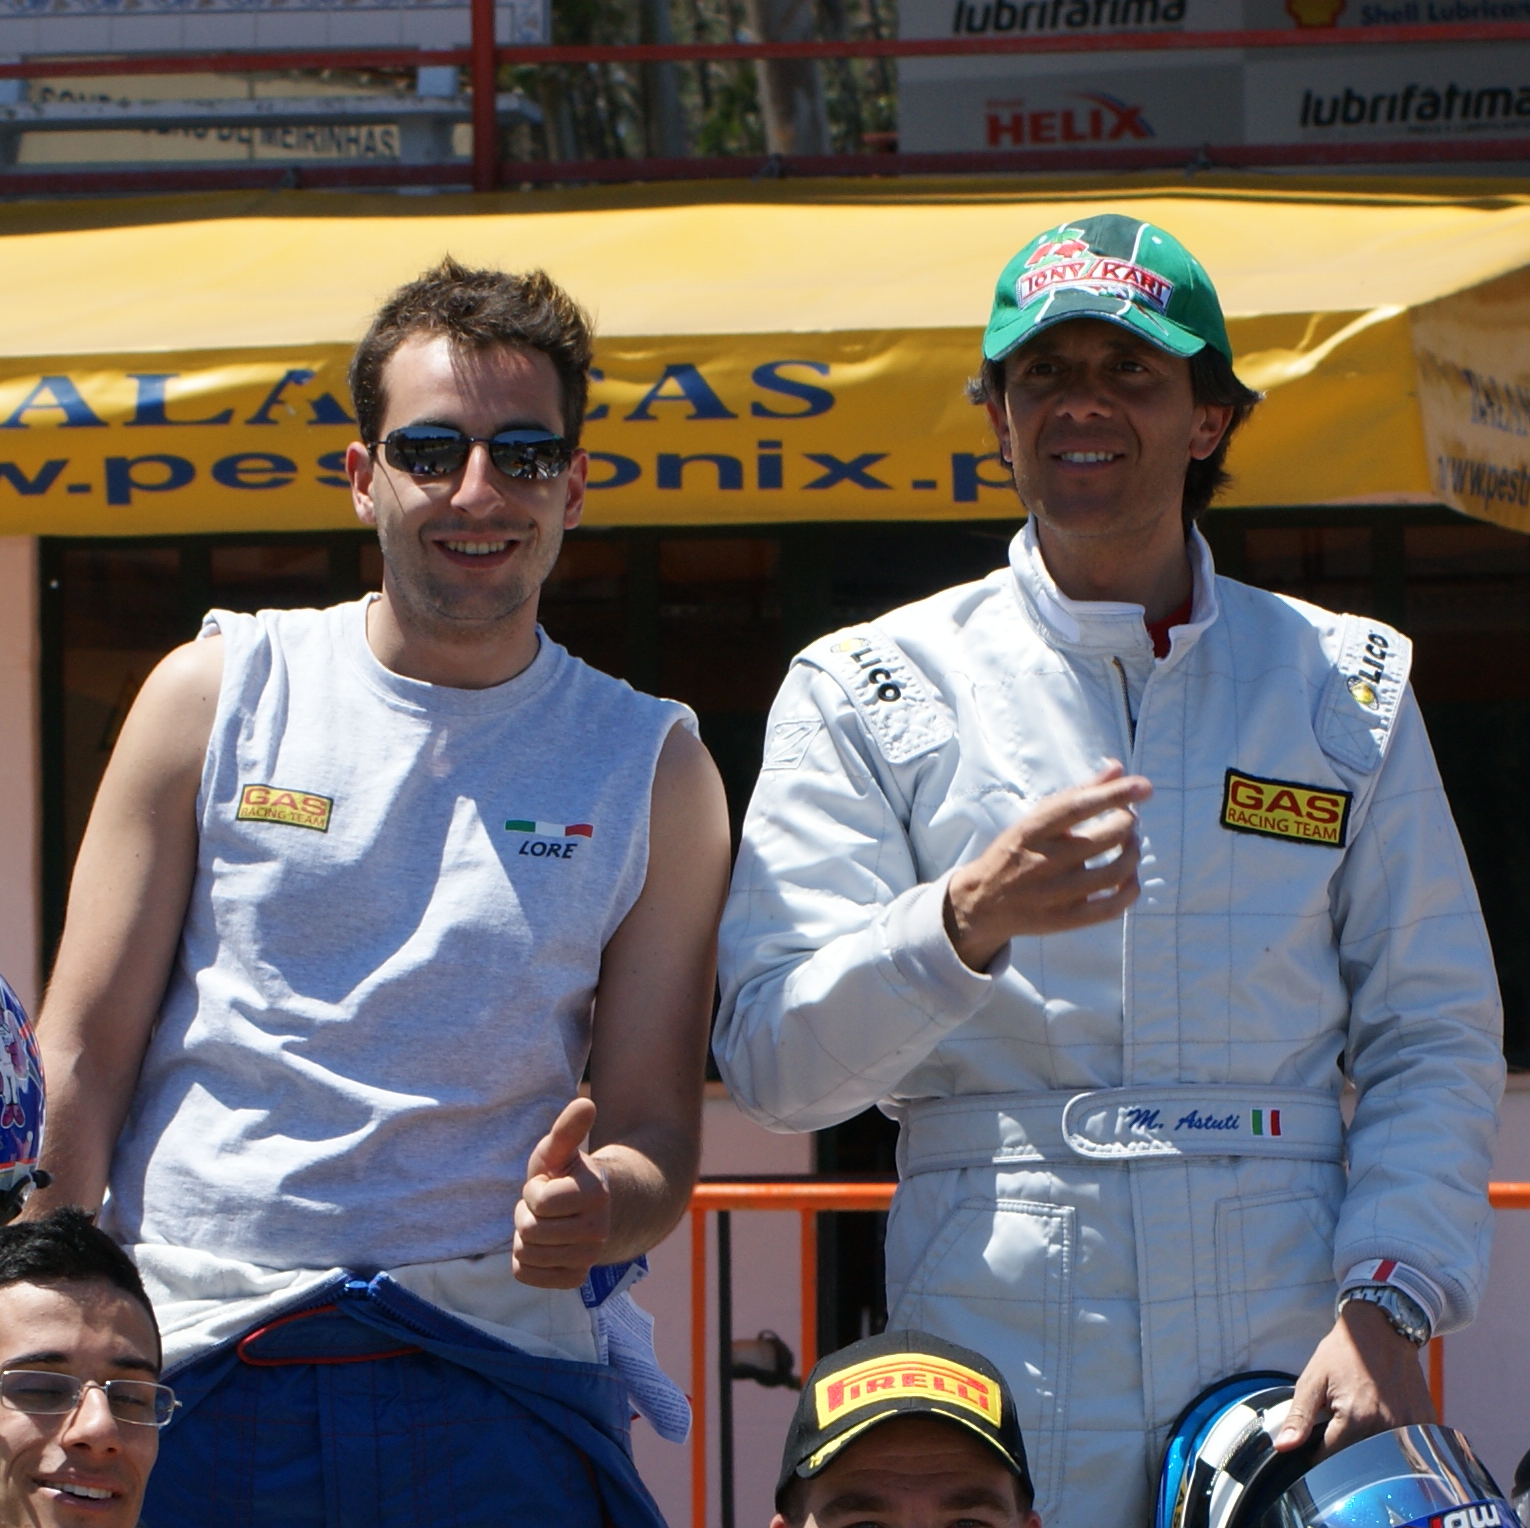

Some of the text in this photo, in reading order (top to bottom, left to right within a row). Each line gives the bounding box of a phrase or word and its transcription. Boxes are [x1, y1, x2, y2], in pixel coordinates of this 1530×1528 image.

[1361, 3, 1420, 26] Shell
[985, 105, 1151, 146] HELIX
[1026, 261, 1170, 298] TONY KART
[850, 647, 901, 702] LICO
[1359, 633, 1389, 684] LICO
[240, 806, 325, 828] RACING TEAM
[244, 787, 327, 817] GAS
[1230, 780, 1340, 824] GAS
[1229, 807, 1339, 843] RACING TEAM
[518, 840, 578, 860] LORE
[1126, 1107, 1240, 1131] M. Astuti
[827, 1362, 990, 1413] PIRELLI
